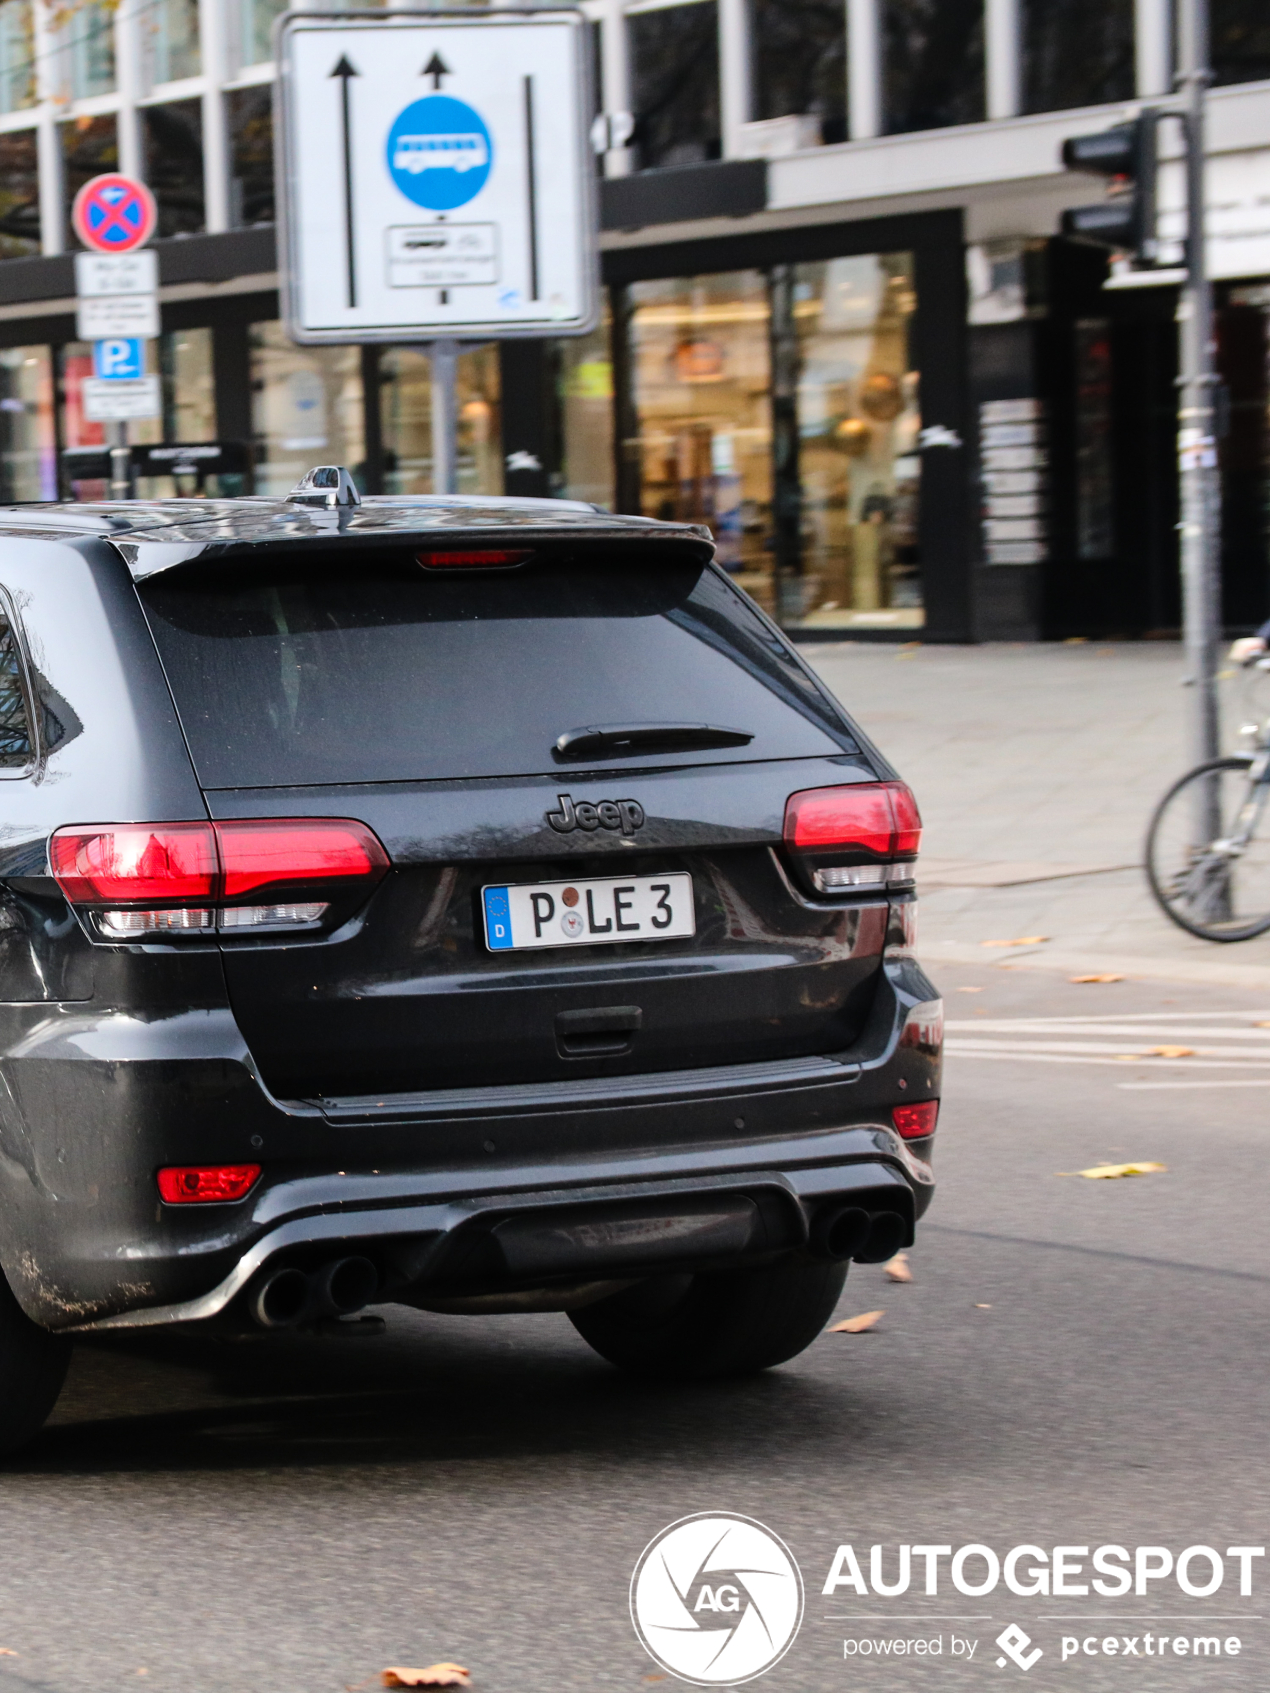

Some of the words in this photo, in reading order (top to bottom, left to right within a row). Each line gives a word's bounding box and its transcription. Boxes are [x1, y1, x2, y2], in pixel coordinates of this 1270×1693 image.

[102, 339, 132, 375] P
[546, 794, 645, 835] Jeep
[530, 892, 555, 938] P
[586, 886, 640, 933] LE
[650, 884, 673, 929] 3
[495, 924, 506, 938] D
